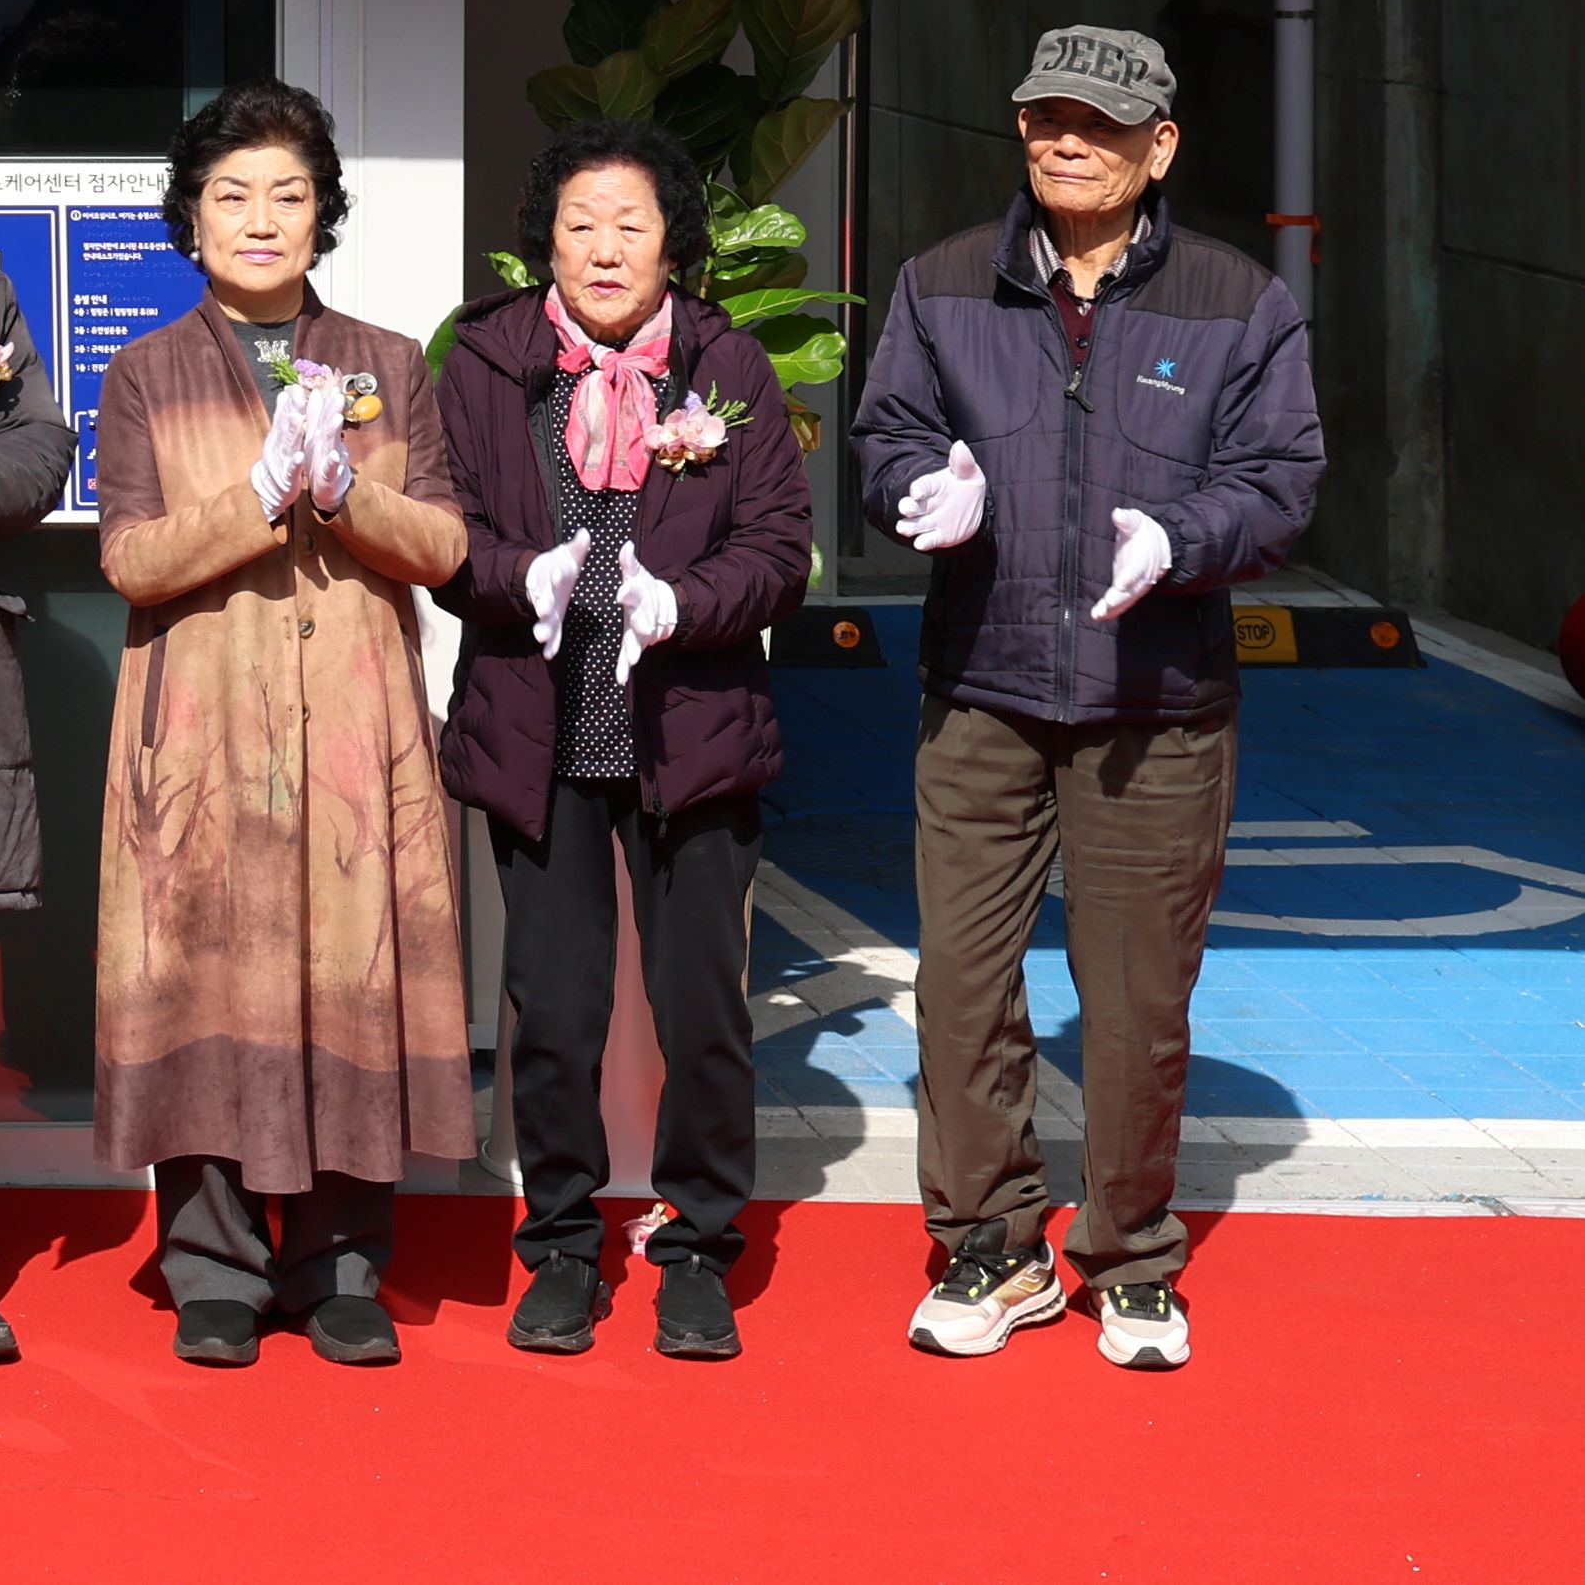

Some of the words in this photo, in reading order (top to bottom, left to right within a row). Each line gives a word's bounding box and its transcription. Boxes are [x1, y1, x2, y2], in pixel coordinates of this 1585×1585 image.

[1042, 34, 1150, 91] JEEP
[88, 173, 172, 194] 점자안내
[91, 294, 108, 305] 안내
[1236, 624, 1270, 642] STOP
